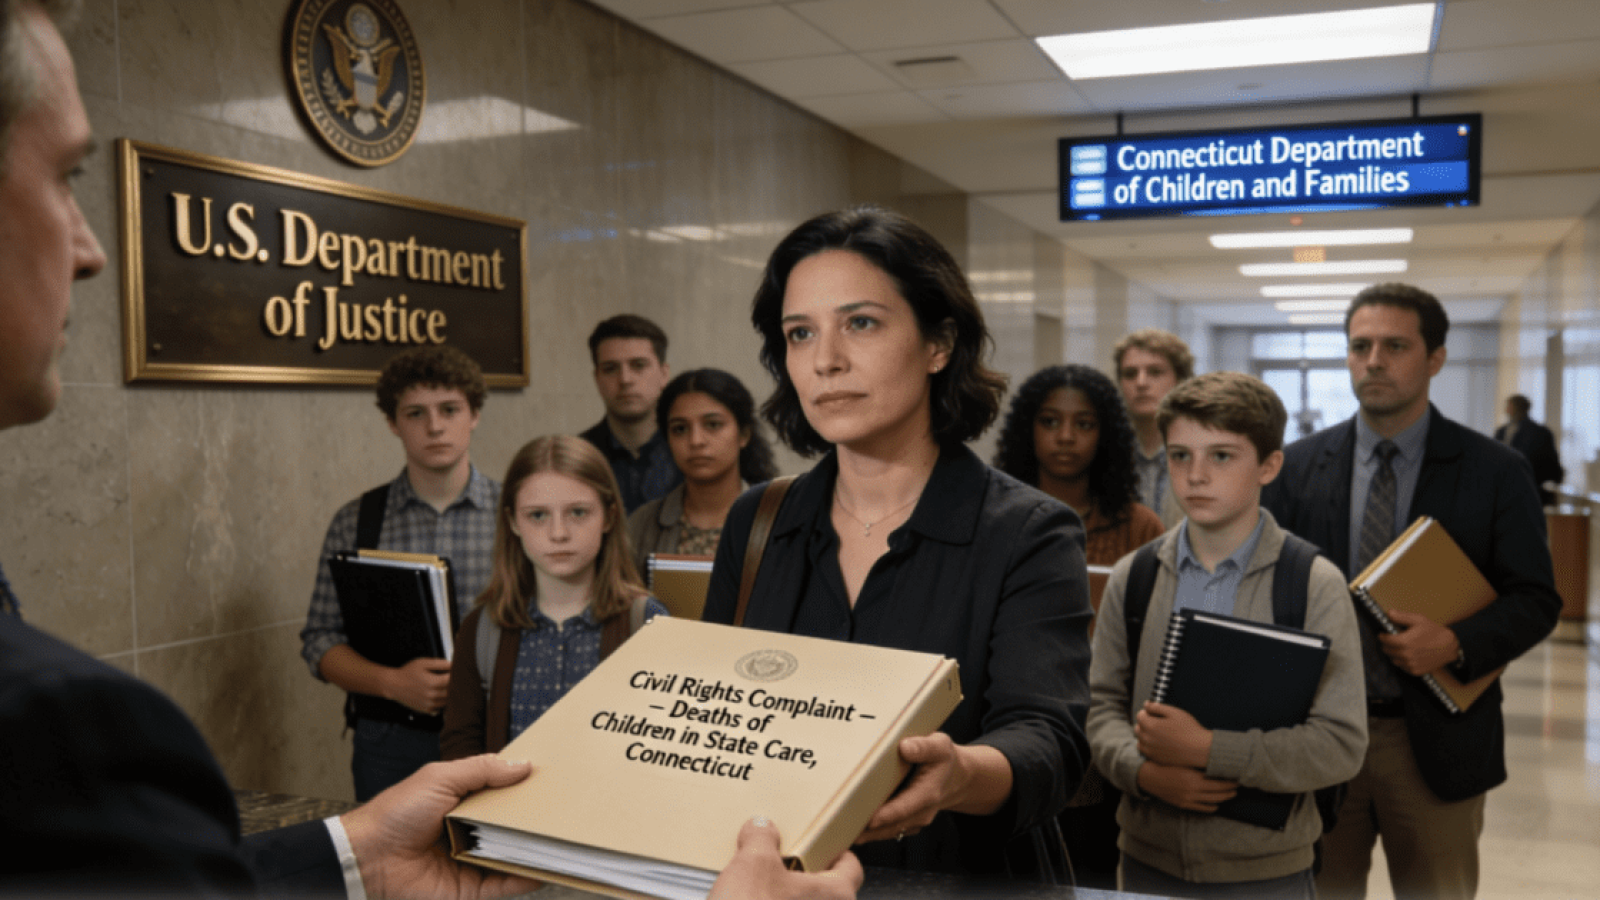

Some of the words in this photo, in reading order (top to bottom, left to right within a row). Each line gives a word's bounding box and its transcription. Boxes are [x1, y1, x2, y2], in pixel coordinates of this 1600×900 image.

[1117, 139, 1264, 171] Connecticut
[1271, 131, 1425, 167] Department
[1114, 175, 1140, 204] of
[1145, 173, 1244, 202] Children
[1252, 169, 1297, 198] and
[1305, 165, 1410, 196] Families
[171, 192, 268, 262] U.S.
[281, 208, 505, 290] Department
[264, 281, 313, 337] of
[319, 286, 447, 350] Justice
[629, 670, 678, 694] Civil
[680, 677, 744, 703] Rights
[748, 689, 856, 722] Complaint
[669, 700, 742, 728] Deaths
[747, 714, 775, 734] of
[590, 711, 676, 742] Children
[680, 727, 699, 746] in
[704, 730, 759, 756] State
[763, 739, 818, 770] Care,
[625, 742, 754, 781] Connecticut
